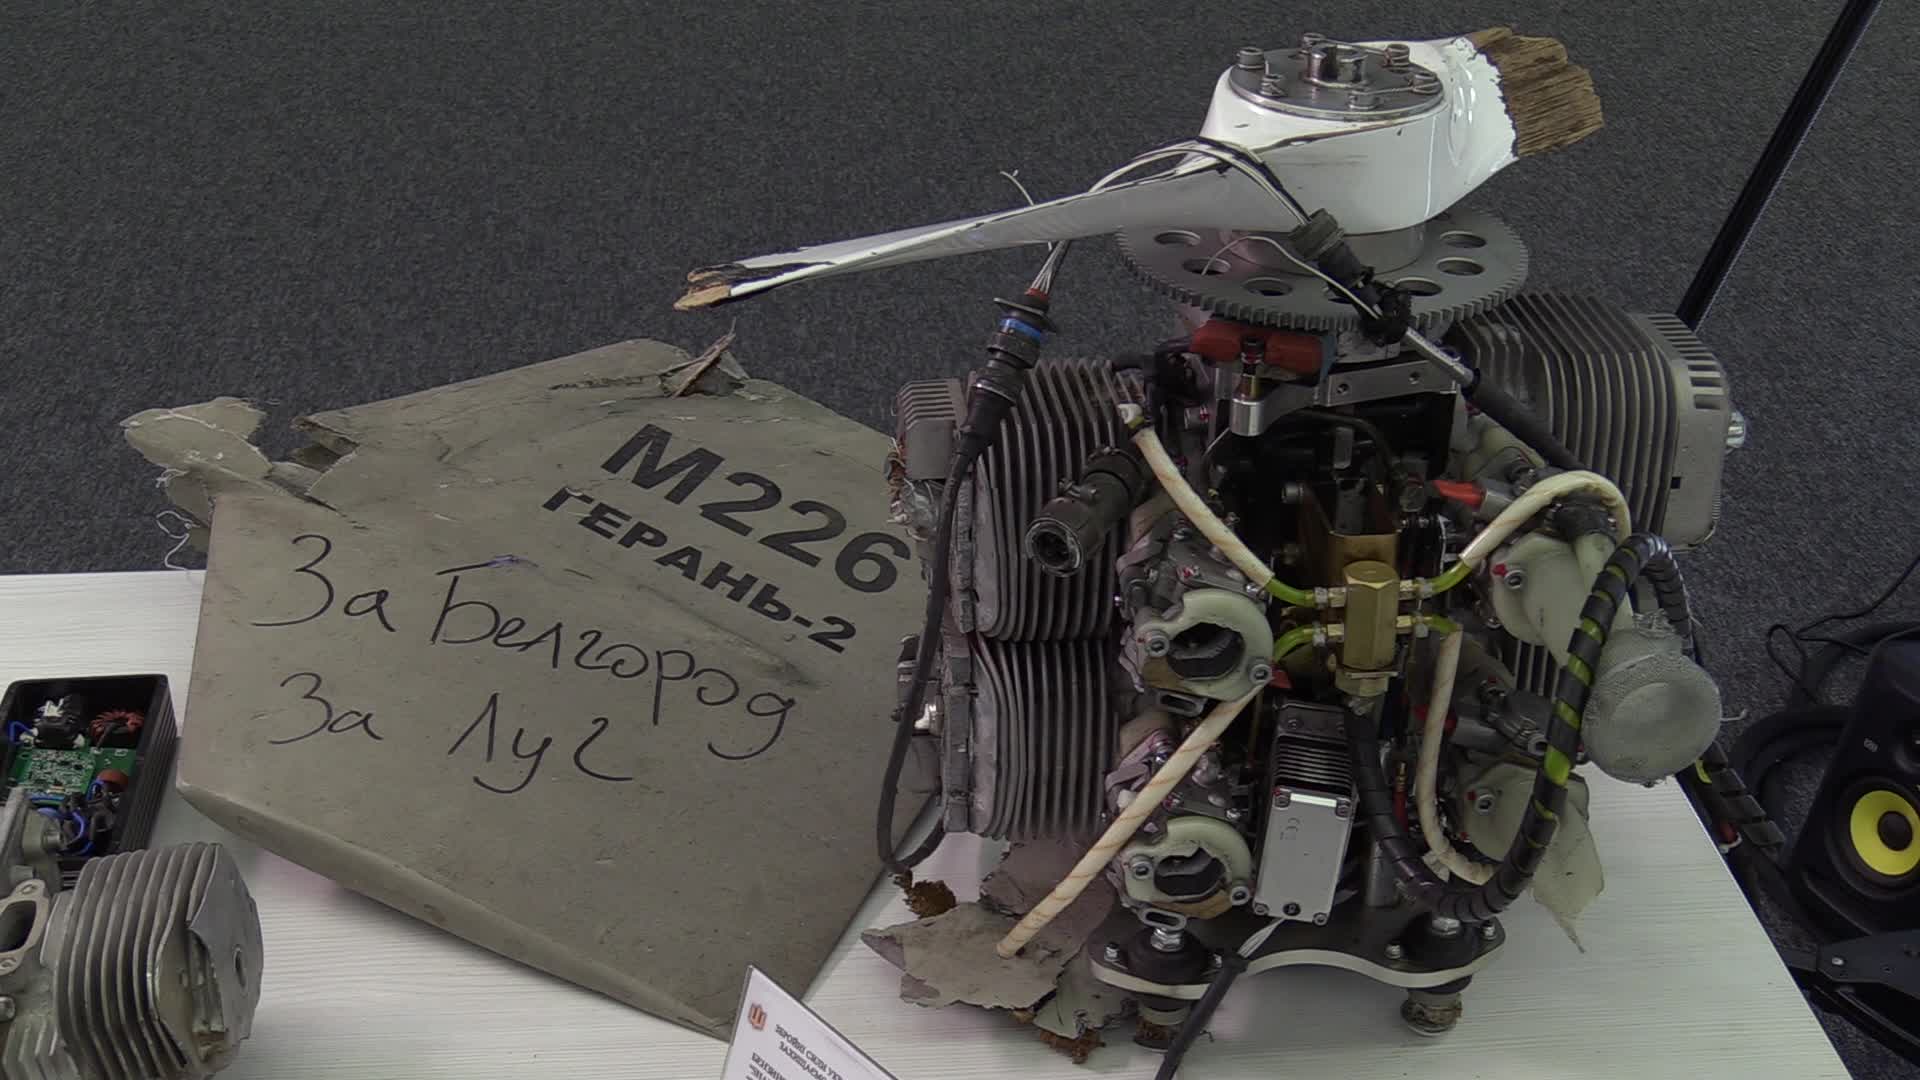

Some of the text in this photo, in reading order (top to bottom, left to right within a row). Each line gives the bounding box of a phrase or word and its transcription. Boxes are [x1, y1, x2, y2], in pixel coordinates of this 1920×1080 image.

[251, 535, 797, 761] За Белгород
[541, 485, 857, 655] ГЕРАНЬ-2
[268, 672, 383, 745] За
